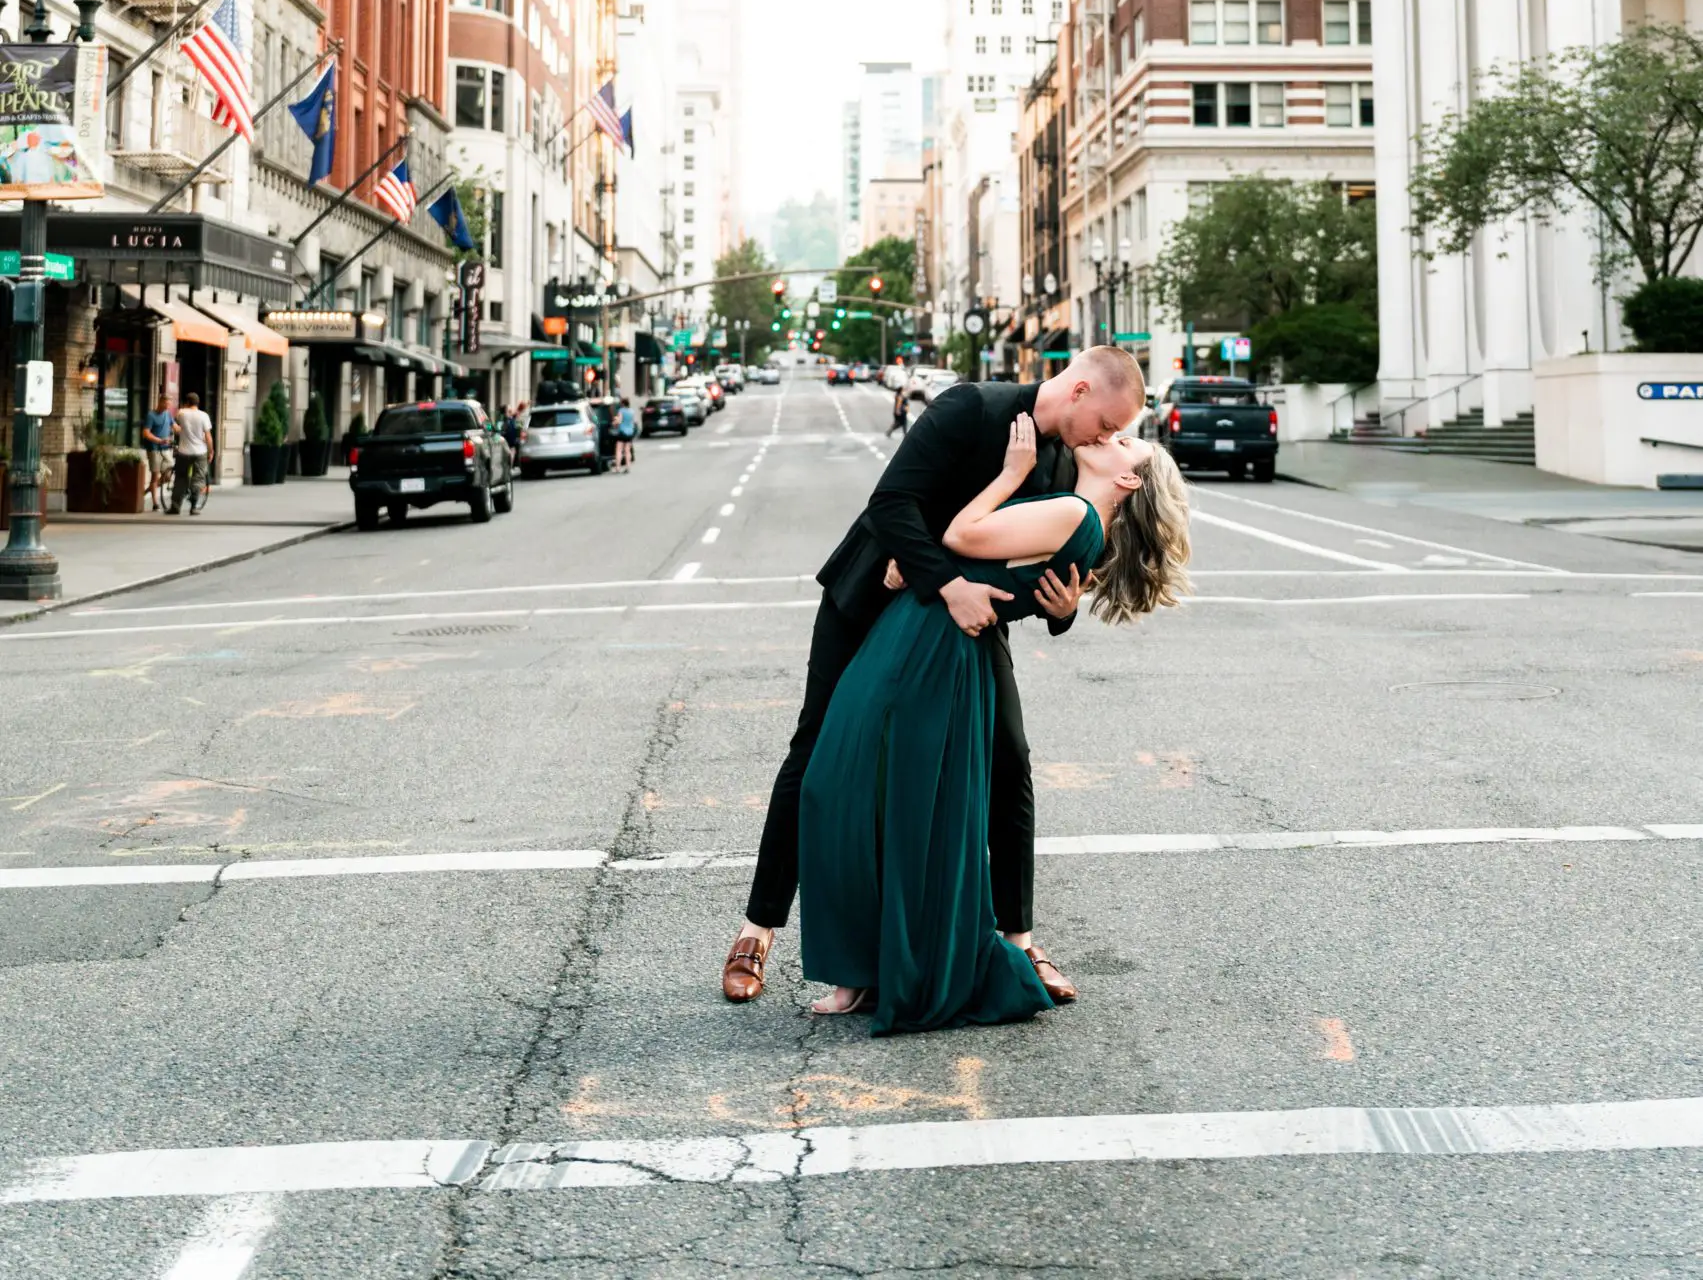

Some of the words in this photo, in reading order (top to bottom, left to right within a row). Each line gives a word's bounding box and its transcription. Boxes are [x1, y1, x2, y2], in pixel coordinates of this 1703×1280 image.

[2, 57, 59, 81] ART
[81, 51, 96, 107] wekend
[0, 90, 70, 113] PEARL
[78, 114, 92, 138] Day
[111, 234, 184, 248] LUCIA
[302, 323, 352, 332] VINTAGE
